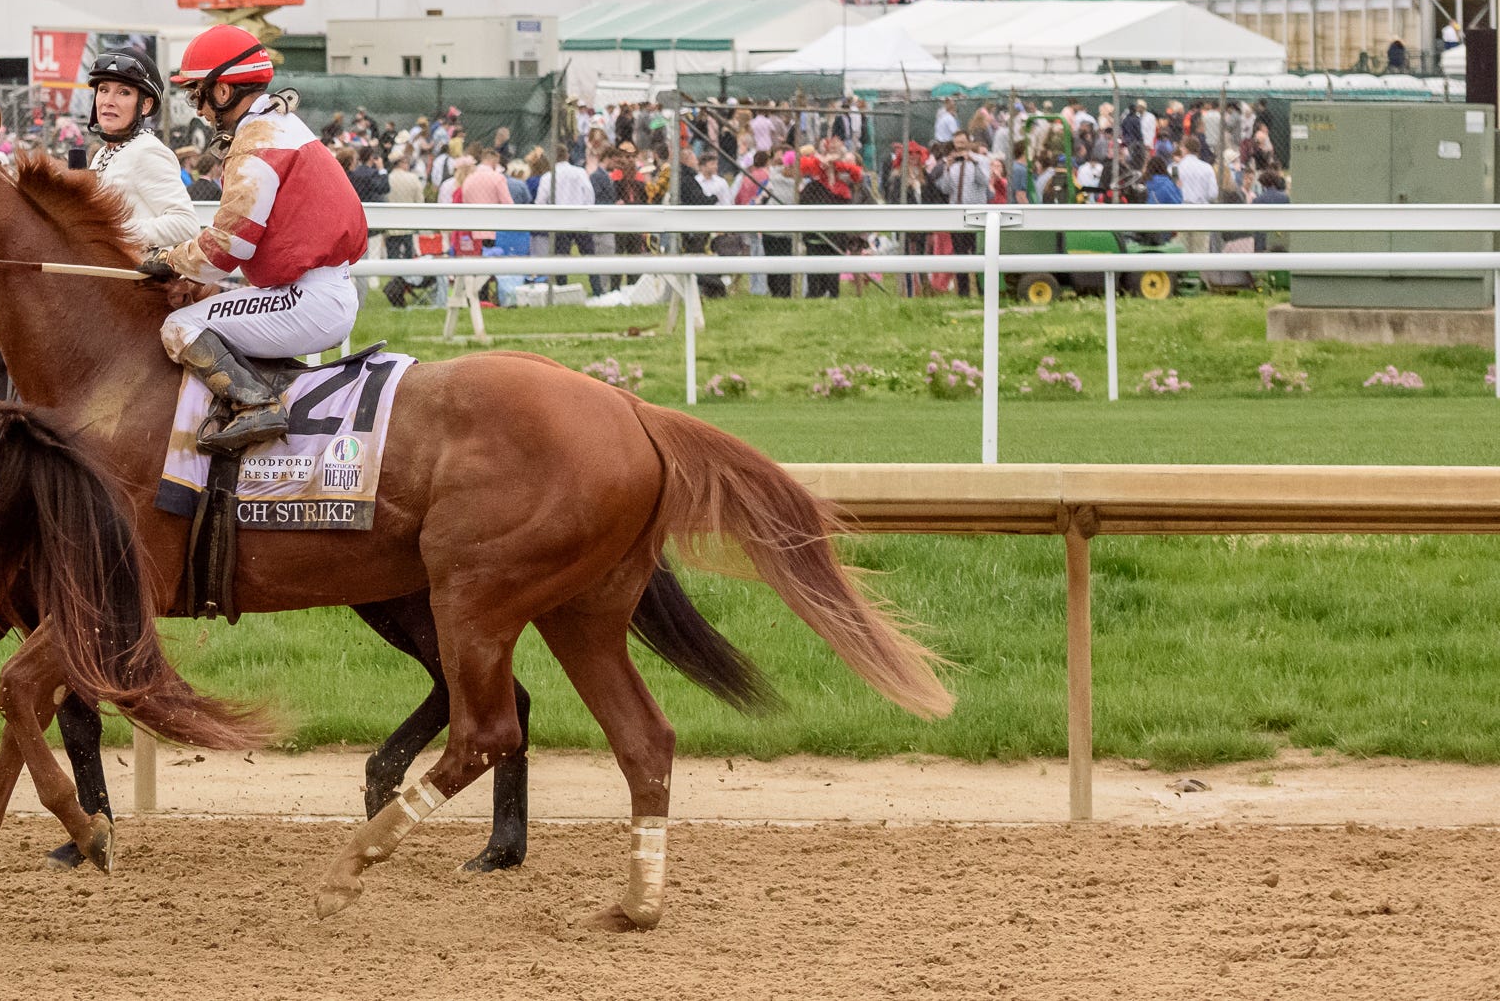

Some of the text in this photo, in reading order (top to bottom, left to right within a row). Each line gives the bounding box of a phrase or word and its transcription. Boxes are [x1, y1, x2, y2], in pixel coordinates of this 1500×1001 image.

[207, 283, 304, 320] PROGRESSIE
[287, 359, 398, 436] 21
[324, 469, 361, 491] DERBY
[275, 502, 356, 522] STRIKE
